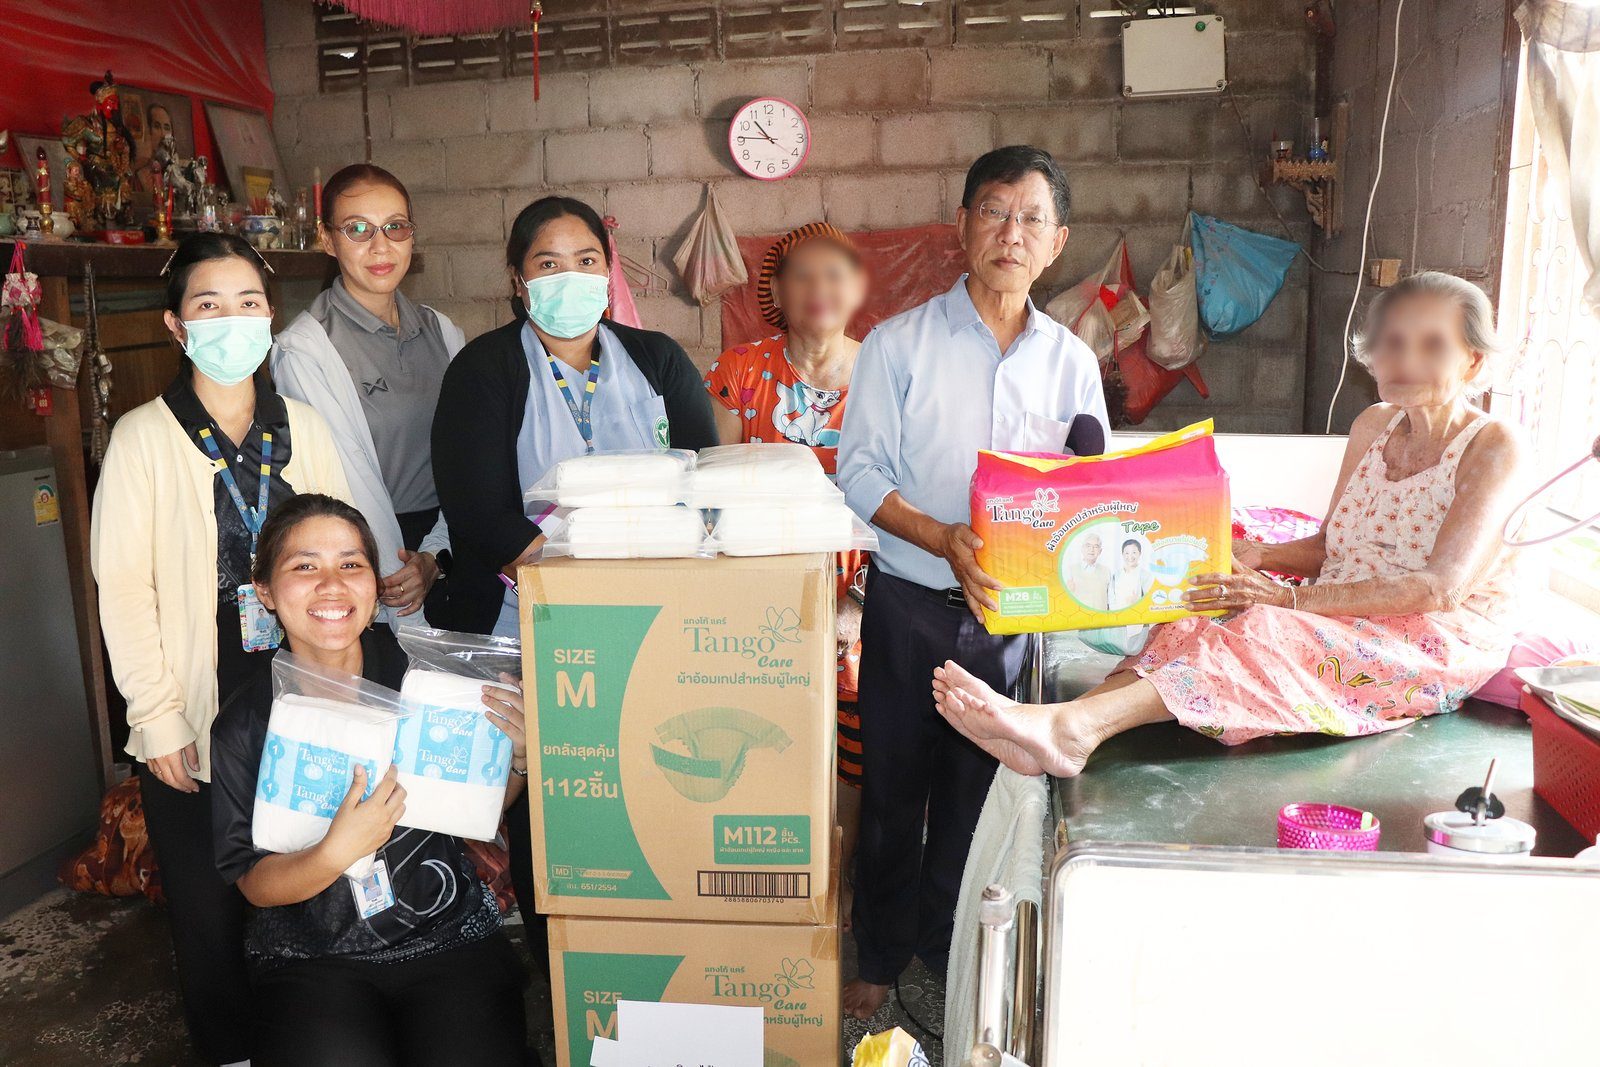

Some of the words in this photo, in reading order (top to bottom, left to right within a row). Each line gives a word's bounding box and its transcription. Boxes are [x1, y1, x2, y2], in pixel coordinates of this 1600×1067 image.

[764, 104, 773, 115] 12
[740, 120, 750, 131] 10
[791, 117, 799, 128] 2
[737, 135, 745, 146] 9
[796, 133, 804, 143] 3
[742, 149, 750, 160] 8
[791, 147, 799, 157] 4
[754, 160, 761, 170] 7
[767, 162, 775, 173] 6
[781, 159, 790, 170] 5
[986, 505, 1043, 522] Tango
[1033, 519, 1054, 528] Care
[1121, 521, 1159, 535] Tape
[1005, 592, 1029, 602] M28
[684, 627, 775, 659] Tango
[554, 648, 596, 665] SIZE
[757, 655, 793, 668] Care
[677, 672, 810, 688] ผ้าอ้อมเทปสำหรับผู้ใหญ่
[556, 670, 596, 708] M
[452, 727, 473, 737] Care
[418, 749, 457, 767] Tango
[543, 742, 615, 763] ยกลังสุดคุ้ม
[446, 765, 467, 775] Care
[543, 771, 618, 798] 112ชิ้น
[723, 826, 777, 845] M112
[705, 974, 790, 1002] Tango
[583, 990, 622, 1005] SIZE
[773, 999, 807, 1010] Care
[585, 1009, 618, 1041] M
